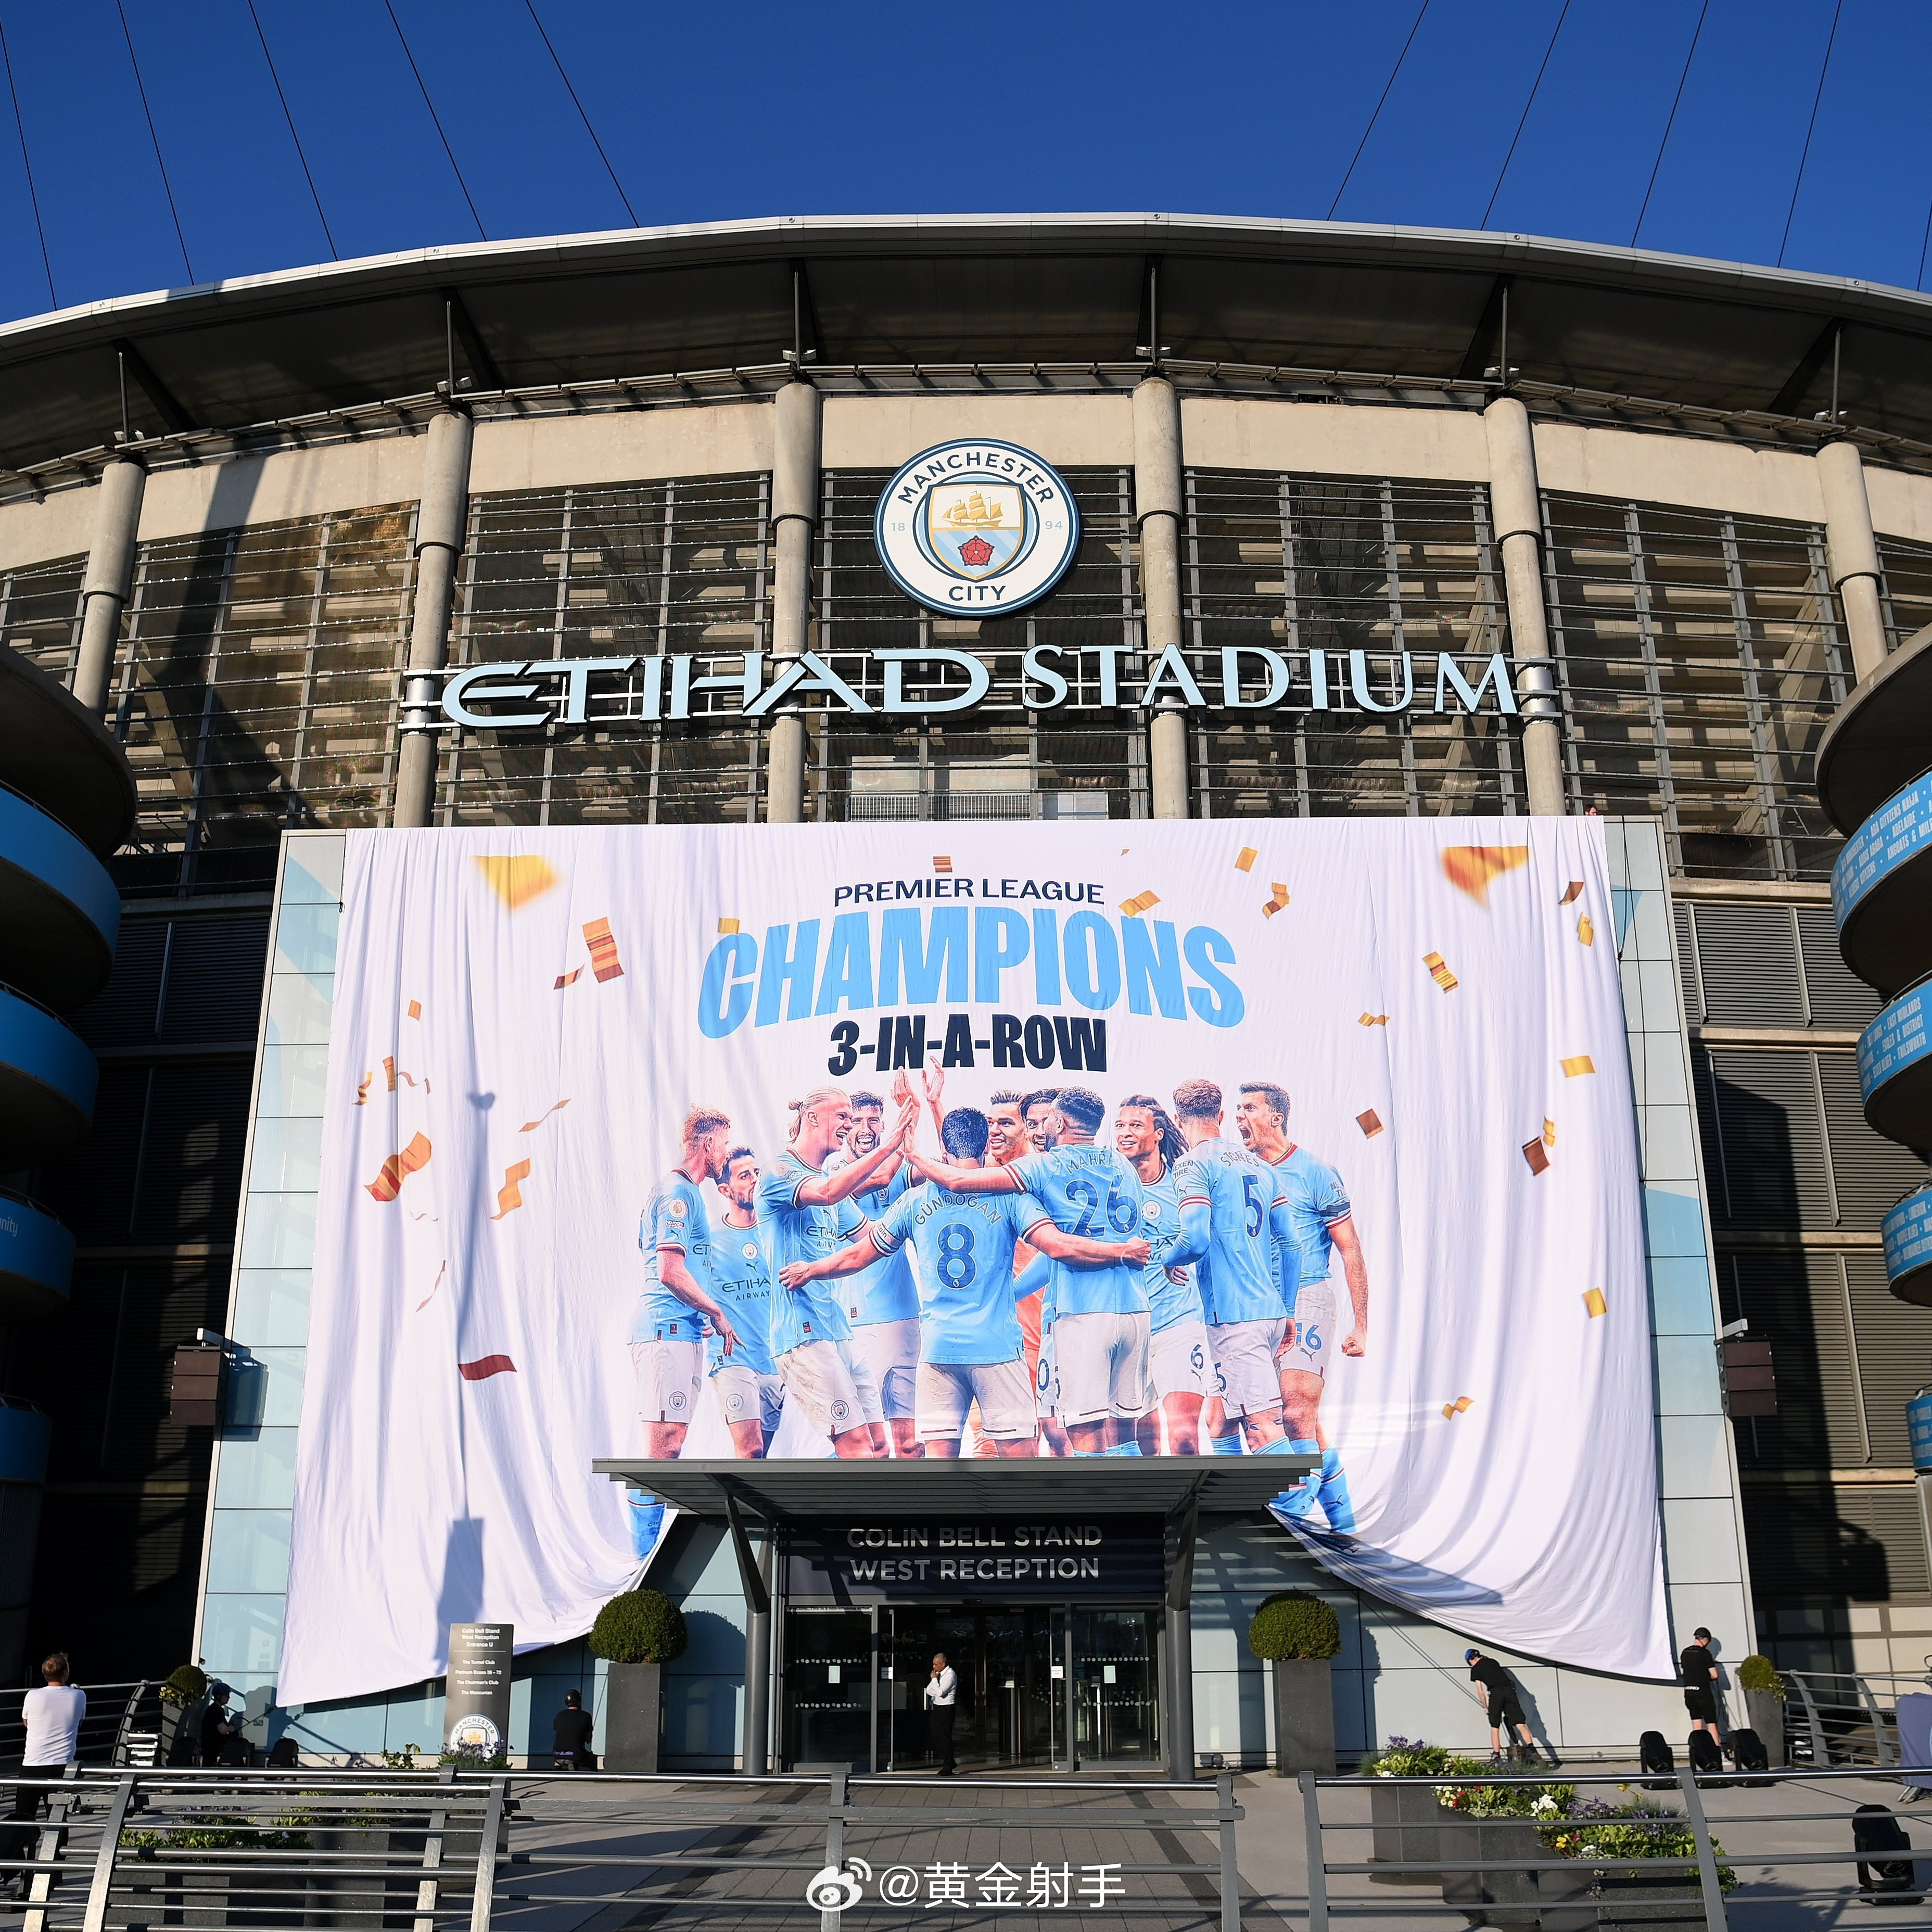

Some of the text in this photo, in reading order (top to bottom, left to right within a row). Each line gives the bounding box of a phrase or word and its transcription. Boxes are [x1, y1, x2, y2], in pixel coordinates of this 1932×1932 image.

[897, 452, 1054, 504] MANCHESTER
[891, 522, 906, 531] 18
[1045, 520, 1063, 530] 94
[949, 586, 1006, 601] CITY
[442, 644, 1517, 727] ETIHAD STADIUM
[834, 878, 1104, 907] PREMIER LEAGUE
[697, 906, 1245, 1039] CHAMPIONS
[828, 1014, 1107, 1076] 3-IN-A-ROW
[1173, 1160, 1193, 1171] EXEN
[1173, 1167, 1189, 1179] TIRE
[914, 1193, 1002, 1225] GÜNDOĞAN
[1065, 1174, 1138, 1238] 26
[1242, 1175, 1264, 1238] 5
[937, 1222, 977, 1290] 8
[722, 1275, 771, 1292] ETIHA
[736, 1290, 770, 1301] AIRWAY
[1295, 1322, 1322, 1350] 16
[1191, 1344, 1204, 1369] 6
[847, 1526, 1102, 1548] COLIN BELL STAND
[850, 1558, 1100, 1581] WEST RECEPTION
[454, 1718, 494, 1734] MANCHESTER
